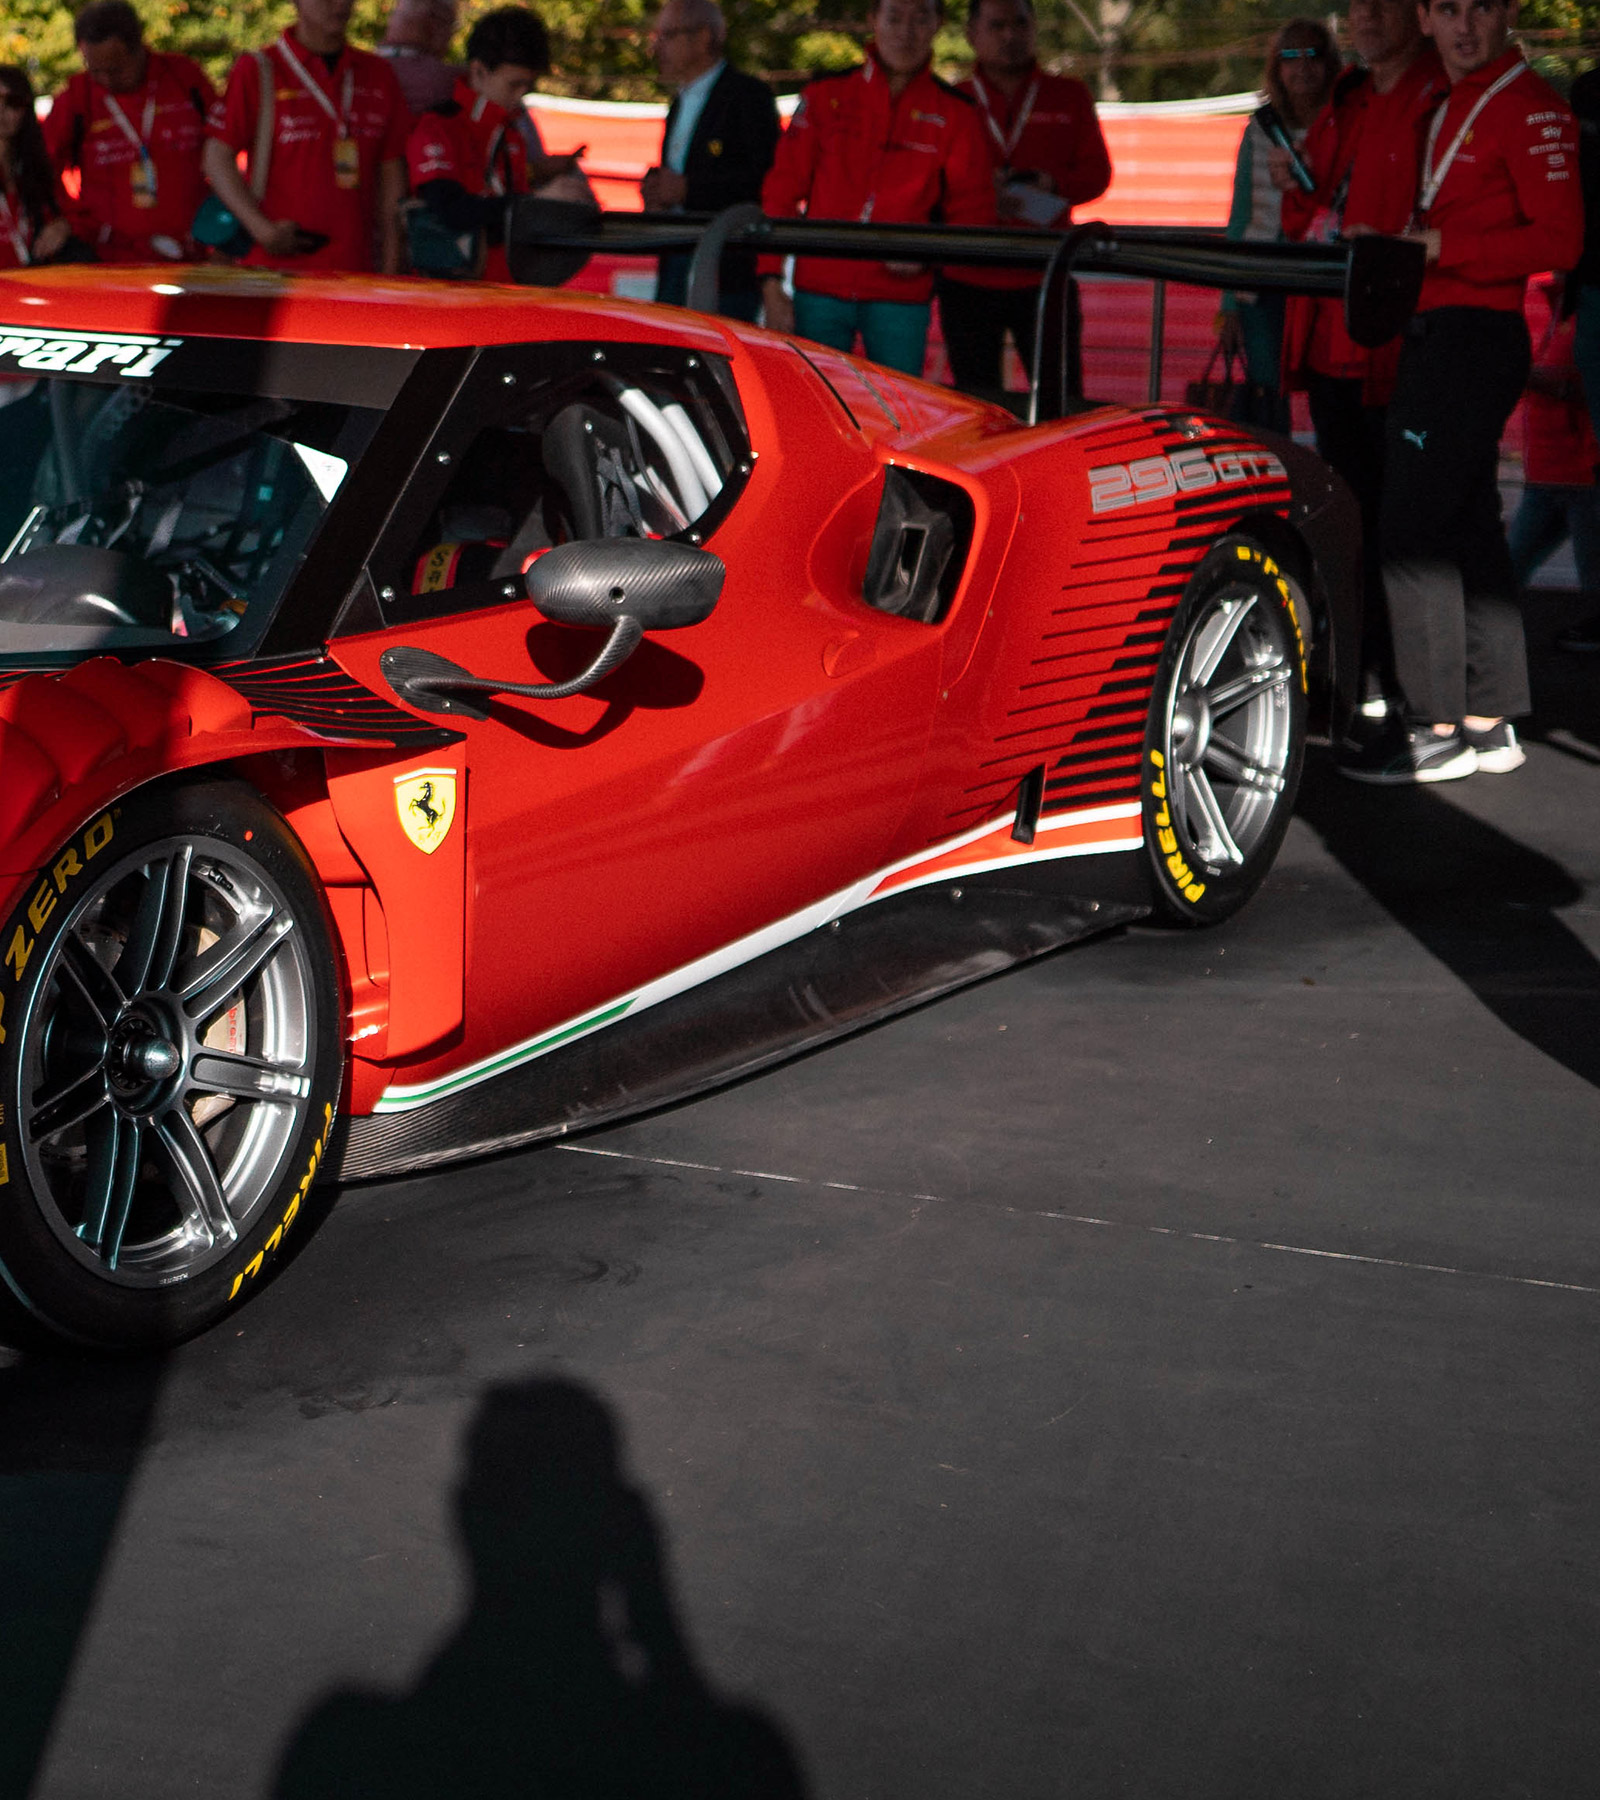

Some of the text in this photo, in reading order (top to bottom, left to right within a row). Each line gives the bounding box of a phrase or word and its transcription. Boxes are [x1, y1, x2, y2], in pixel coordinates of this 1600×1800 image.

[1088, 448, 1217, 513] 296
[5, 812, 114, 981] ZERO
[1150, 749, 1206, 903] PIRELLI
[228, 1102, 332, 1301] PIRELLI
